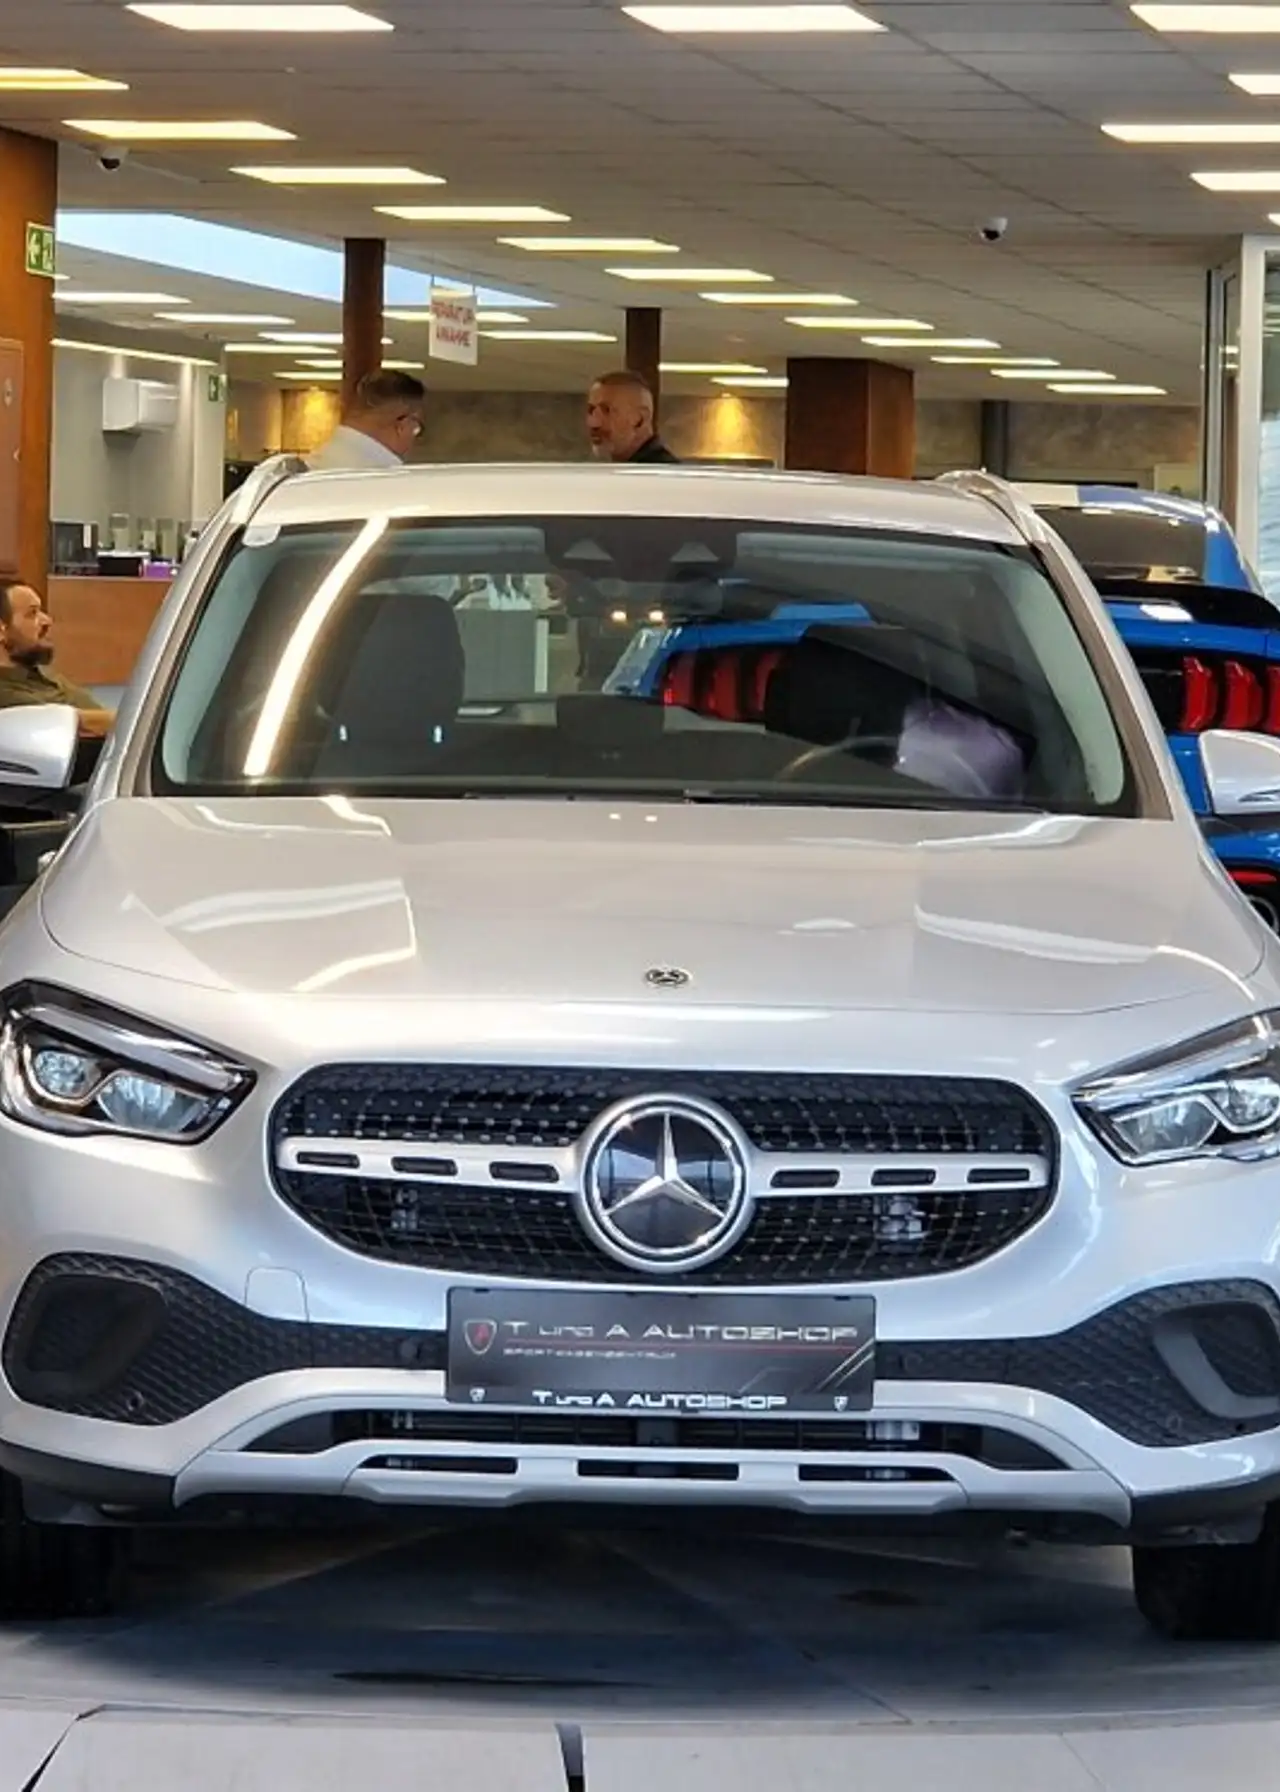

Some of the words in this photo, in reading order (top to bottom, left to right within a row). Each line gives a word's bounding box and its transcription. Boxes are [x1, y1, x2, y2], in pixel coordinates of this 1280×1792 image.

[503, 1321, 530, 1337] T
[605, 1324, 631, 1339] A
[642, 1323, 859, 1342] AUTOSHOP
[626, 1392, 788, 1409] AUTOSHOP
